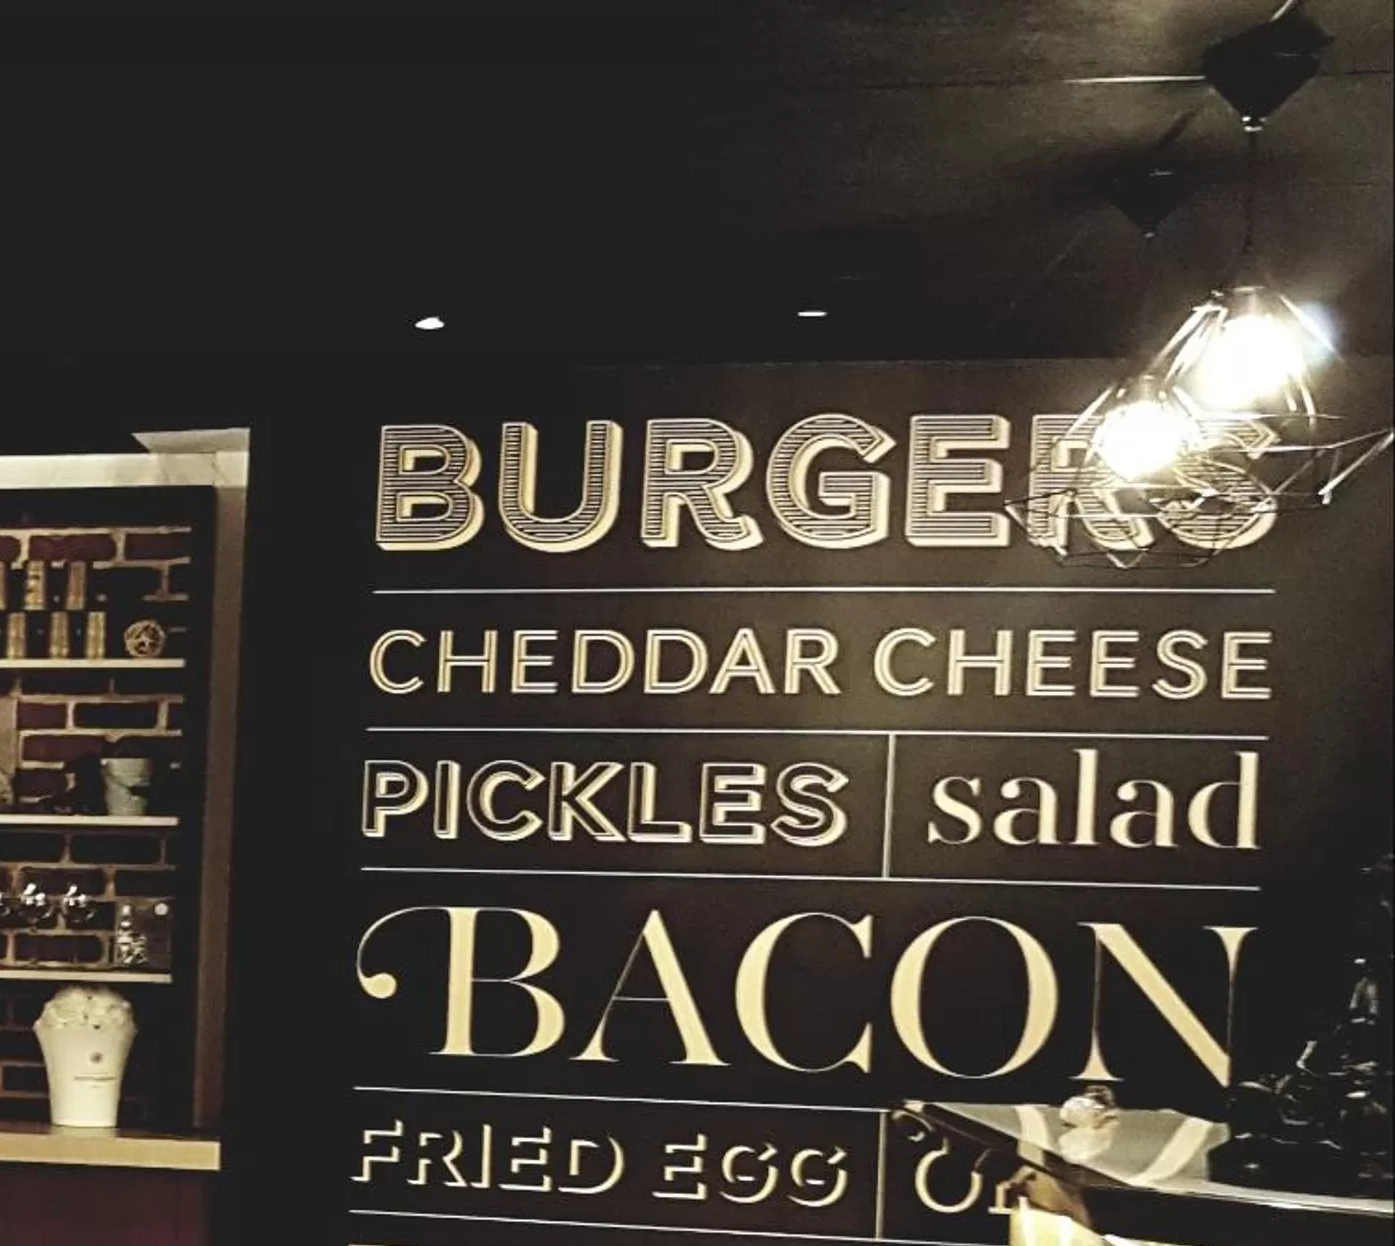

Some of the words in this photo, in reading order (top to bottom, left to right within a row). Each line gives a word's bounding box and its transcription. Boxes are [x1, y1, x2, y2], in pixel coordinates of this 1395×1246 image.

[375, 413, 1278, 553] BURGERS
[369, 628, 841, 697] CHEDDAR
[873, 628, 1274, 701] CHEESE
[361, 760, 849, 848] PICKLES
[926, 748, 1262, 850] salad
[356, 905, 1259, 1088] BACON
[350, 1119, 626, 1195] FRIED
[652, 1134, 849, 1208] EGG
